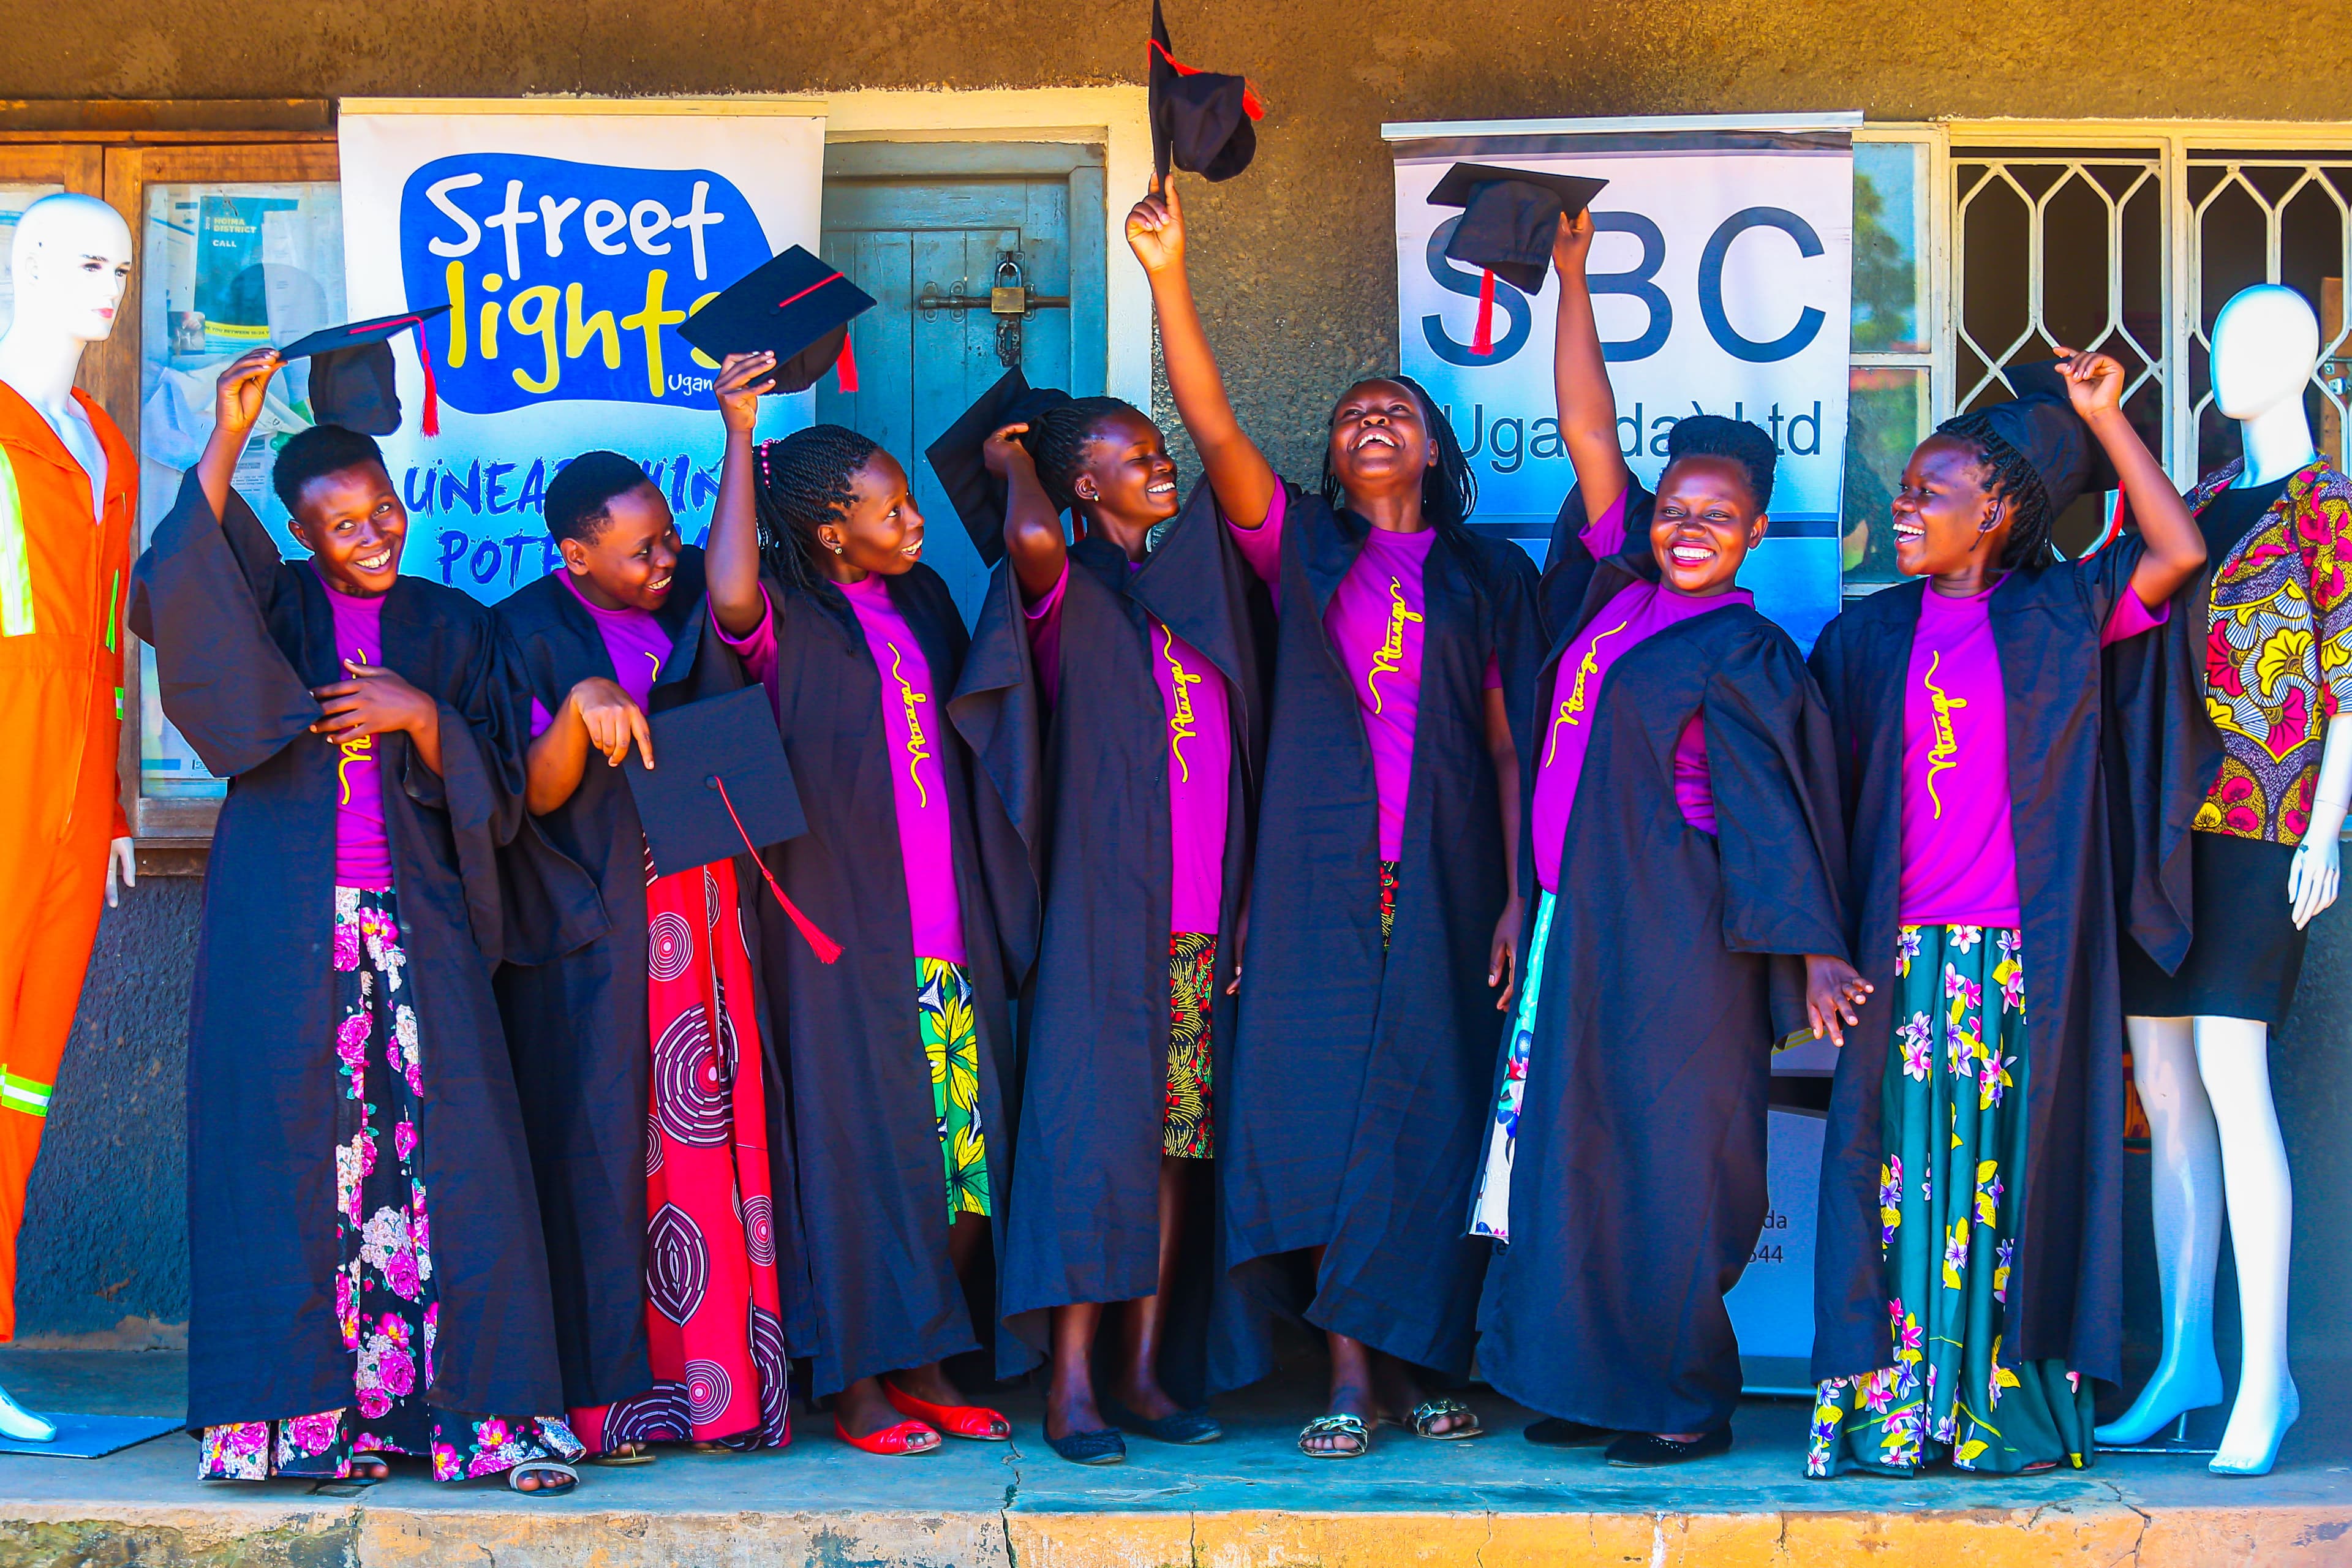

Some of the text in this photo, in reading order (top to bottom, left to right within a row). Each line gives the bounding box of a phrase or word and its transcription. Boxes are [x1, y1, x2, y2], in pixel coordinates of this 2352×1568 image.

[213, 225, 257, 234] DISTRICT
[425, 173, 725, 281] Street
[1422, 206, 1826, 367] SBC
[668, 374, 713, 396] Ugan
